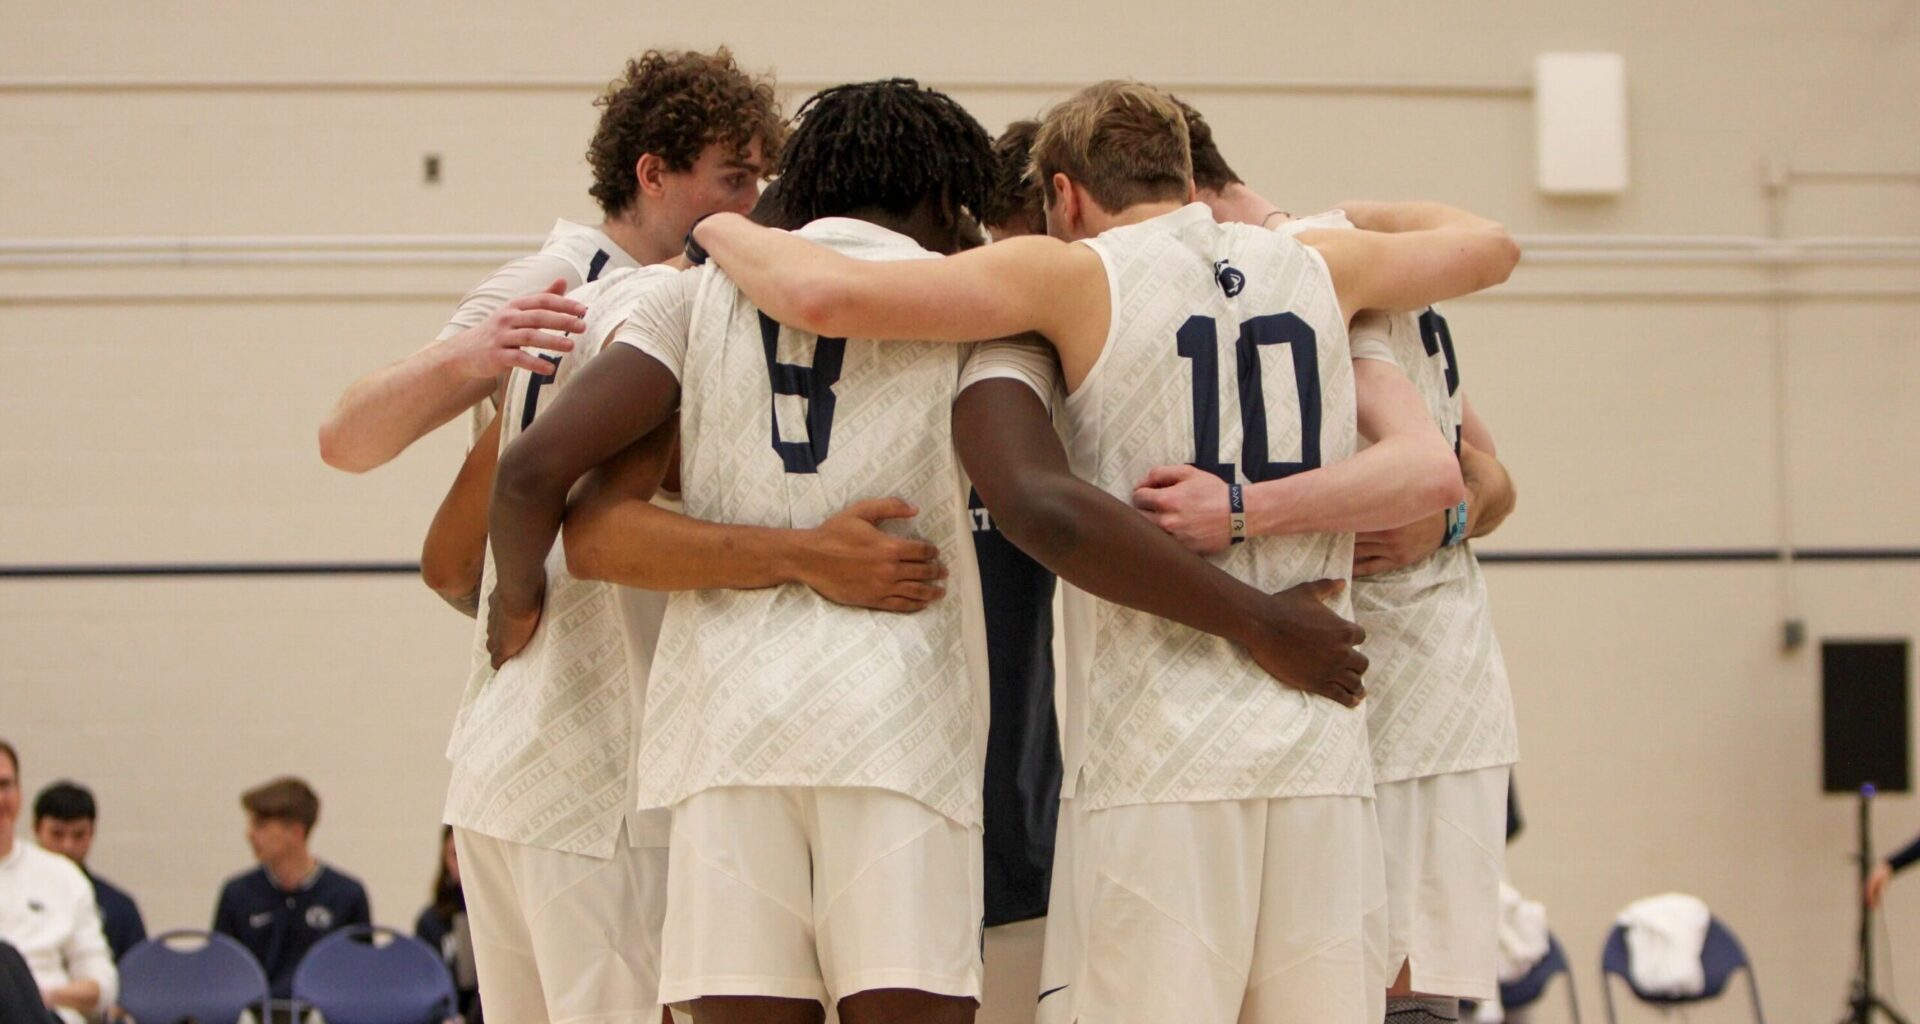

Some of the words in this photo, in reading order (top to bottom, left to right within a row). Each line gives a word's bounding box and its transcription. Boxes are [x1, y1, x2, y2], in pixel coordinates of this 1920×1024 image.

[1122, 340, 1159, 387] PENN
[757, 308, 846, 473] 8
[1177, 311, 1322, 484] 10
[1124, 417, 1157, 456] ARE
[552, 660, 588, 694] ARE
[546, 716, 578, 747] WE
[579, 689, 613, 724] ARE
[746, 746, 777, 779] WE
[776, 714, 811, 756] ARE
[807, 679, 850, 721] PENN
[838, 705, 880, 747] PENN
[1374, 713, 1408, 766] PENN
[1402, 670, 1440, 724] STATE
[1185, 746, 1221, 786] ARE
[1216, 712, 1255, 752] PENN
[507, 758, 555, 800] STATE
[529, 791, 580, 830] STATE
